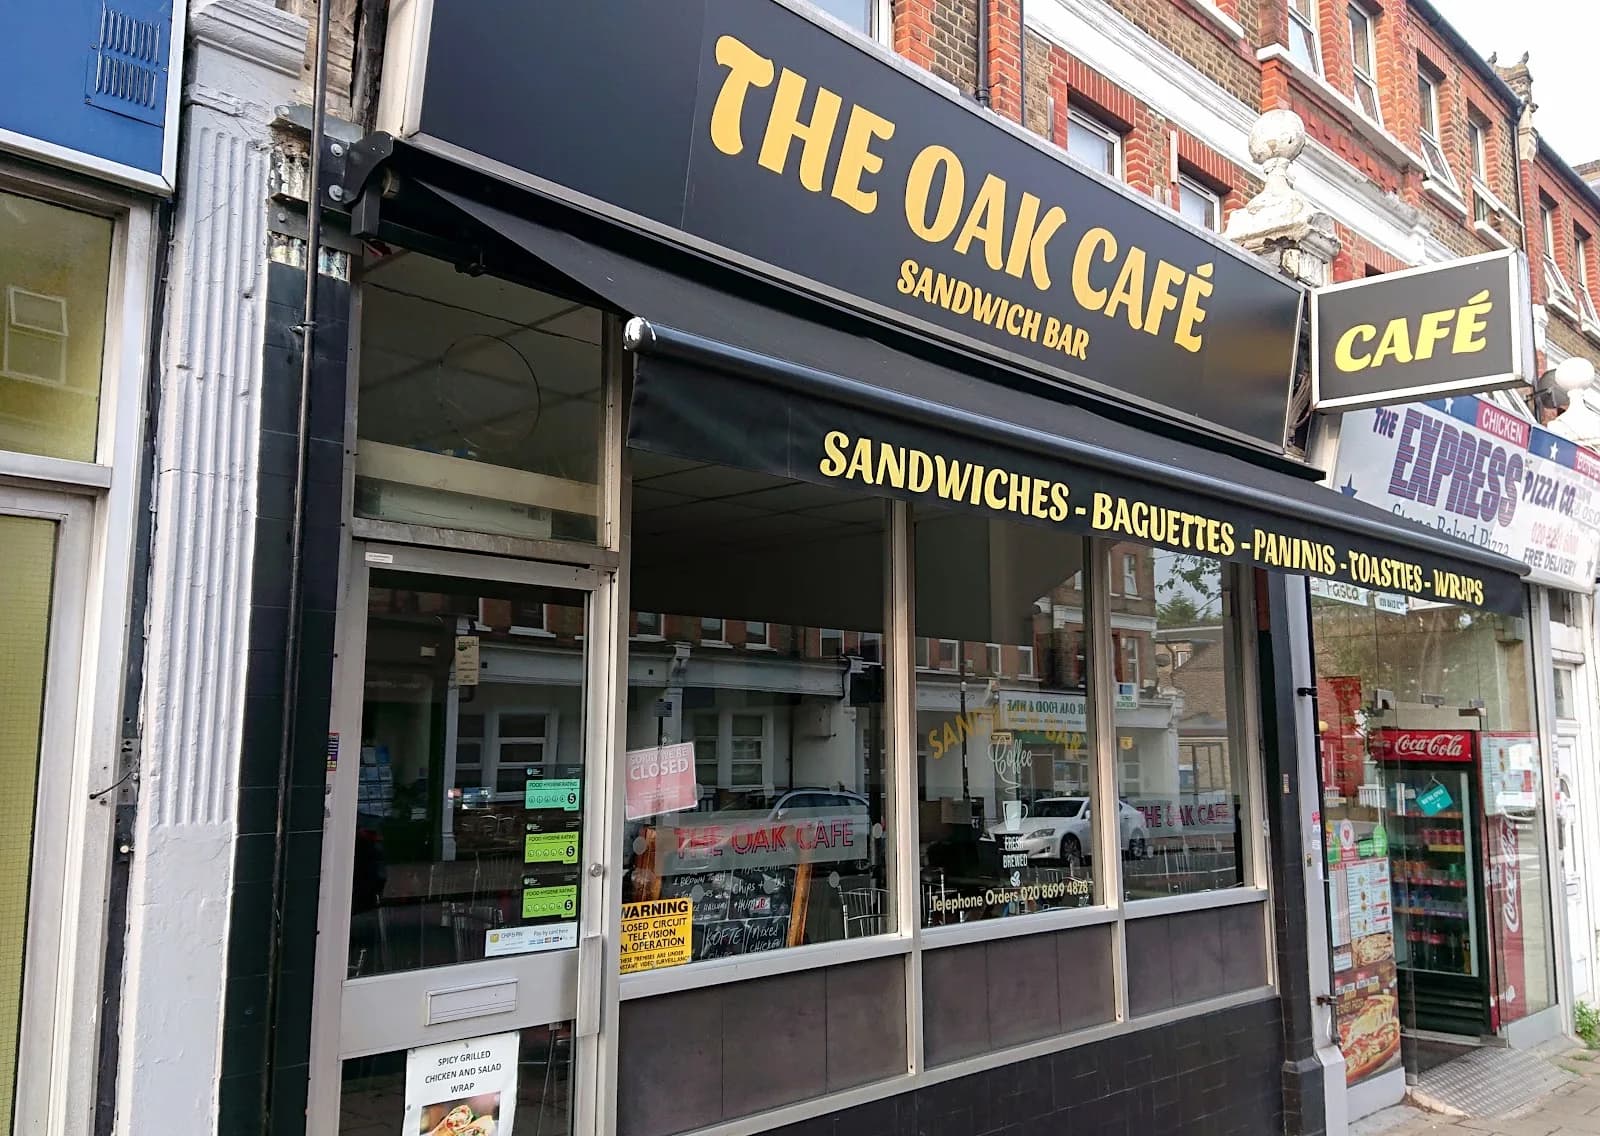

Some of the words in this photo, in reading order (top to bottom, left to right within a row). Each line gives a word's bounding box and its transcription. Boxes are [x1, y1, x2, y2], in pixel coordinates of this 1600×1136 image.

[710, 35, 896, 214] THE
[905, 145, 1066, 290] OAK
[1072, 228, 1213, 353] CAFÉ
[897, 259, 1042, 342] SANDWICH
[1042, 314, 1089, 361] BAR
[1335, 289, 1493, 372] CAFÉ
[1482, 408, 1523, 444] CHICKEN
[1372, 407, 1399, 439] THE
[1388, 408, 1524, 527] EXPRESS
[1522, 470, 1559, 511] PIZZA
[819, 430, 1070, 522] SANDWICHES
[1092, 492, 1235, 556] BAGUETTES
[1254, 528, 1337, 576] PANINIS
[1348, 550, 1423, 594] TOASTIES
[1433, 568, 1485, 606] WRAPS
[1523, 547, 1544, 568] FREE
[1544, 553, 1577, 577] DELIVERY
[988, 737, 1032, 776] Coffee
[1394, 734, 1464, 757] Coca-Cola
[630, 758, 689, 780] CLOSED
[674, 826, 722, 859] THE
[732, 824, 788, 854] OAK
[796, 820, 854, 850] CAFE
[1004, 836, 1024, 850] FRESH
[1003, 854, 1028, 868] BREWED
[932, 893, 983, 913] Telephone
[986, 889, 1018, 904] Orders
[1021, 885, 1040, 900] 020
[1042, 882, 1065, 898] 8699
[1066, 879, 1089, 895] 4828
[621, 922, 649, 933] LOSED
[653, 918, 687, 929] CIRCUIT
[628, 928, 676, 942] TELEVISION
[706, 927, 743, 946] KOFTE
[620, 943, 628, 953] N
[631, 937, 685, 951] OPERATION
[438, 1055, 459, 1066] SPICY
[460, 1050, 491, 1062] GRILLED
[425, 1070, 457, 1084] CHICKEN
[459, 1067, 476, 1077] AND
[478, 1063, 502, 1074] SALAD
[450, 1082, 475, 1093] WRAP
